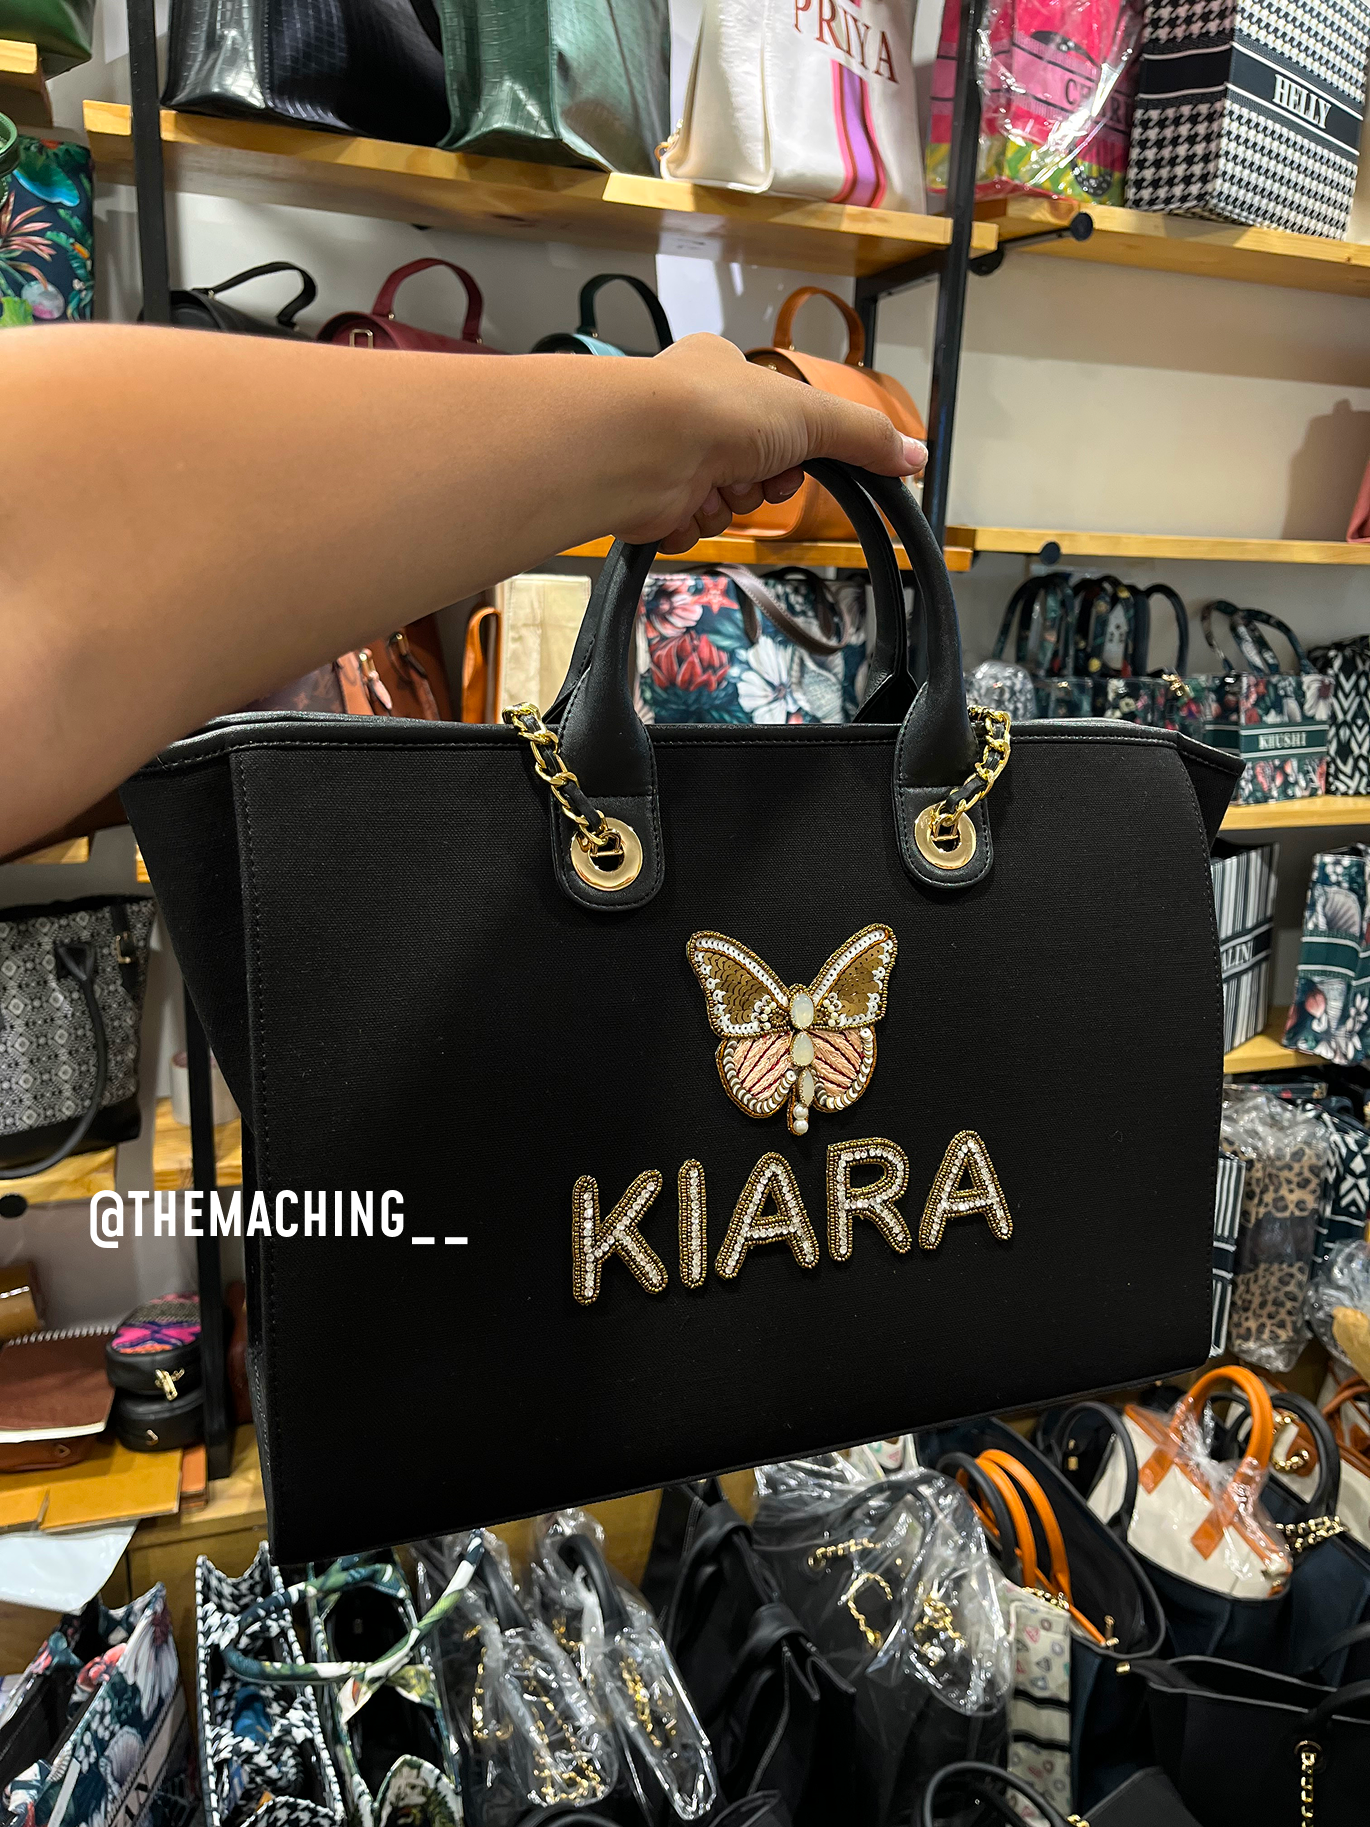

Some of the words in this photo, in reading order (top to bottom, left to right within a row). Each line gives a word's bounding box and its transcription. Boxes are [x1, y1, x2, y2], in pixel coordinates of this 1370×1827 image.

[793, 0, 900, 84] PRIYA
[1272, 73, 1332, 129] HELLY
[1259, 731, 1307, 750] KHUSHI
[572, 1129, 1014, 1306] KIARA
